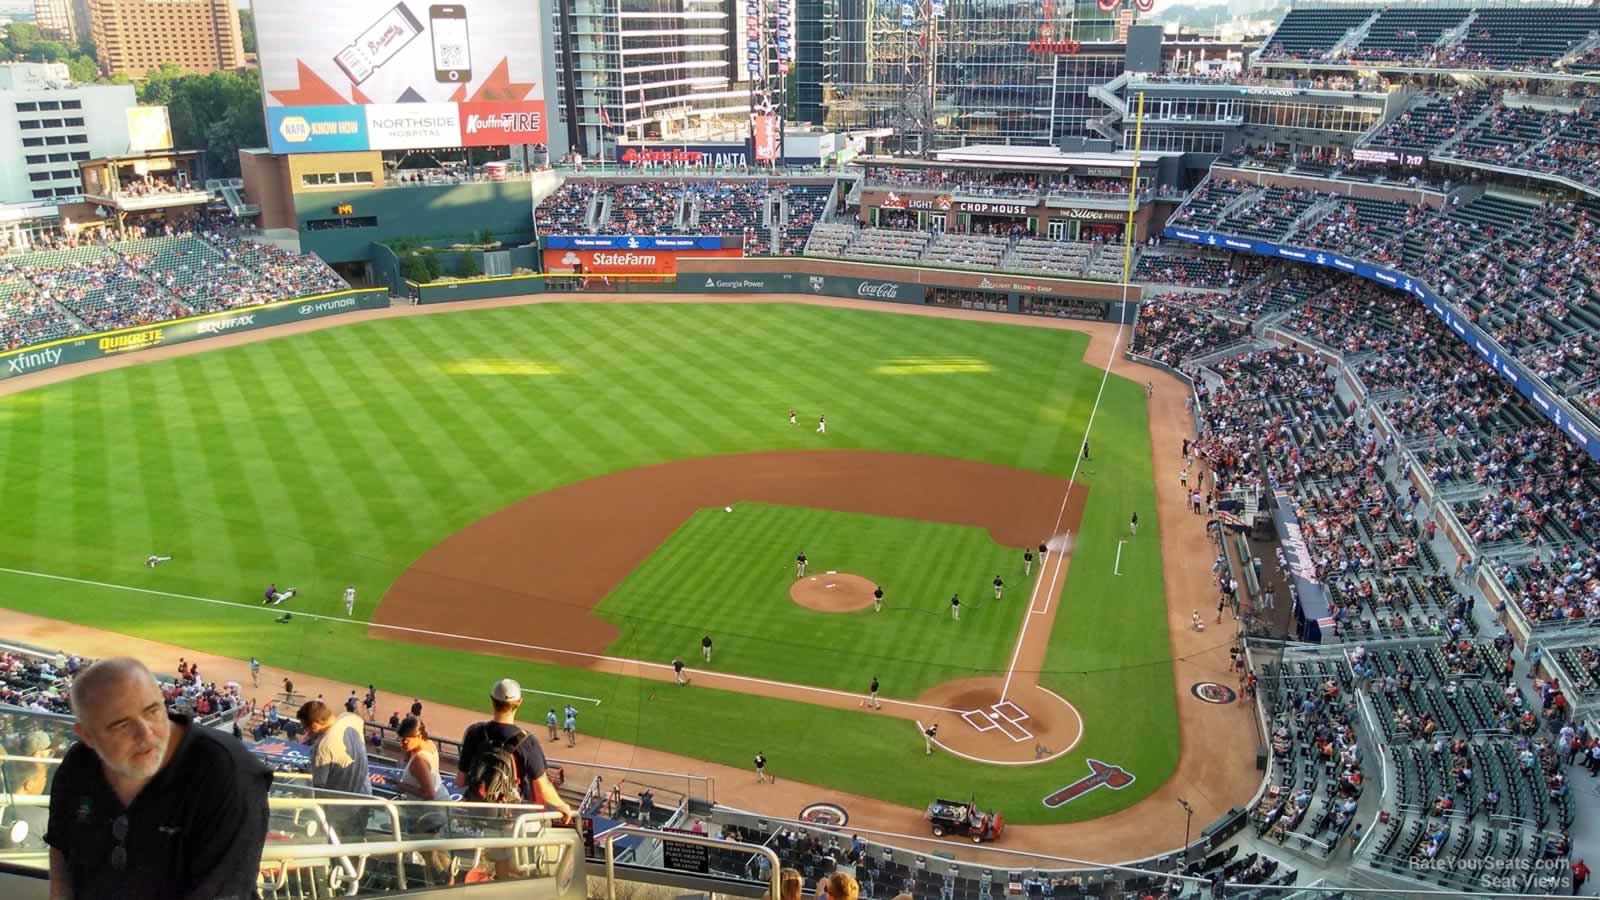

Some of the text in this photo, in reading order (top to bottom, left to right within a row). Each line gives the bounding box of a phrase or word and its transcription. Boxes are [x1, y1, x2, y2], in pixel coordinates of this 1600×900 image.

[1029, 37, 1080, 55] xfinity
[285, 123, 305, 135] NAPA
[311, 120, 358, 135] KNOW HOW
[372, 117, 455, 129] NORTHSIDE
[502, 112, 540, 132] TIRE
[388, 129, 440, 137] HOSPITAL
[695, 152, 747, 168] ATLANTA
[909, 200, 932, 209] LIGHT
[960, 202, 1027, 215] CHOP HOUSE
[1070, 208, 1103, 219] Silver
[716, 279, 764, 289] Georgia Power
[314, 297, 355, 313] HYUNDAI
[197, 314, 256, 334] EQUIFAX
[98, 329, 163, 350] QUIKRETE
[7, 347, 63, 373] xfinity
